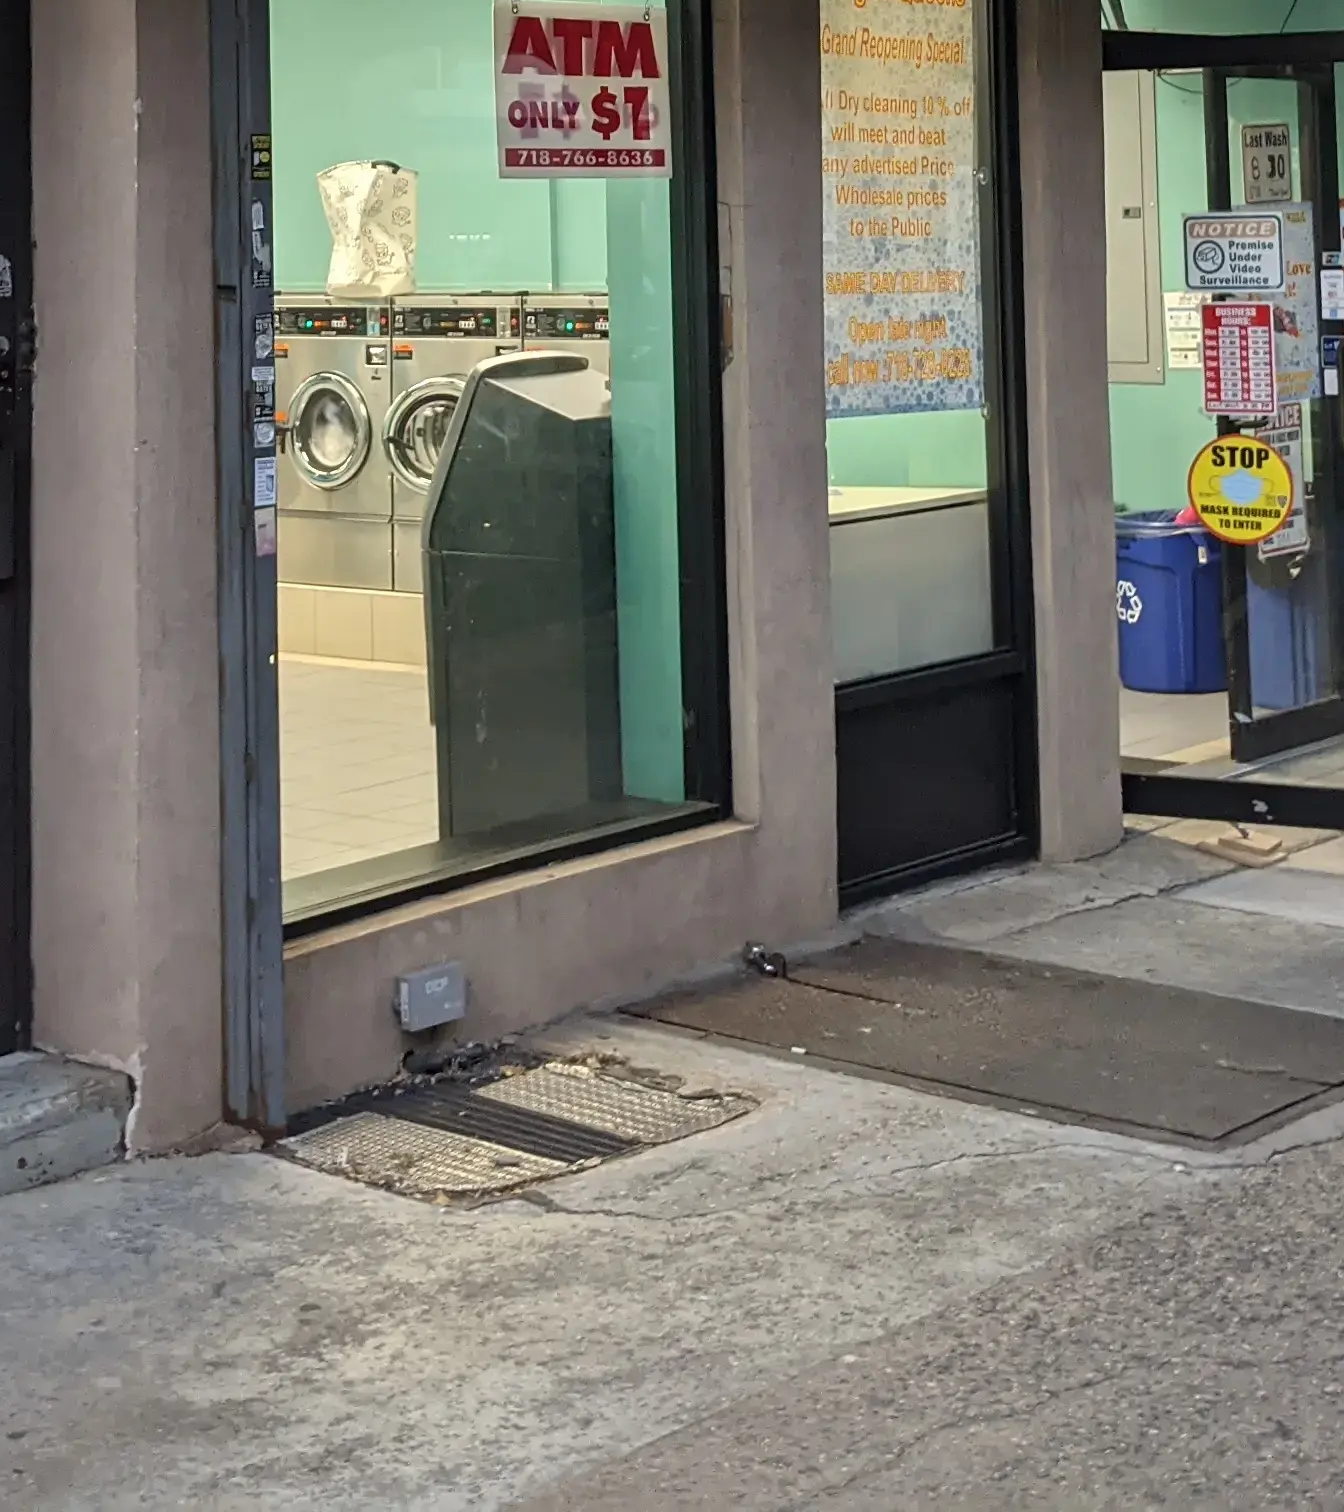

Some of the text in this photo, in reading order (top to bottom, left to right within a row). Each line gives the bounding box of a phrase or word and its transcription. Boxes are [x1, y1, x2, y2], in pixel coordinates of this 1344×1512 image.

[502, 16, 662, 78] ATM
[821, 24, 856, 57] Grand
[859, 27, 923, 69] Reopening
[508, 86, 651, 140] ONLY $1
[838, 90, 859, 116] Dry
[863, 92, 918, 119] cleaning
[954, 96, 971, 116] off
[831, 121, 946, 146] will meet and beat
[1244, 129, 1288, 148] Last Wash
[517, 150, 654, 166] 718-766-8636
[823, 155, 955, 178] any advertised Price
[835, 185, 947, 210] Wholesale prices
[850, 217, 932, 237] to the Public
[1192, 222, 1272, 236] NOTICE
[1228, 240, 1274, 250] Premise
[1229, 252, 1263, 262] Under
[1229, 263, 1261, 274] Video
[826, 270, 965, 294] SAME DAY DELIVERY
[1199, 275, 1269, 285] Surveillance
[1216, 307, 1256, 317] BUSINESS
[848, 316, 884, 346] Open
[1211, 445, 1269, 468] STOP
[1200, 504, 1281, 519] MASK REQUIRED
[1219, 518, 1262, 530] TO ENTER
